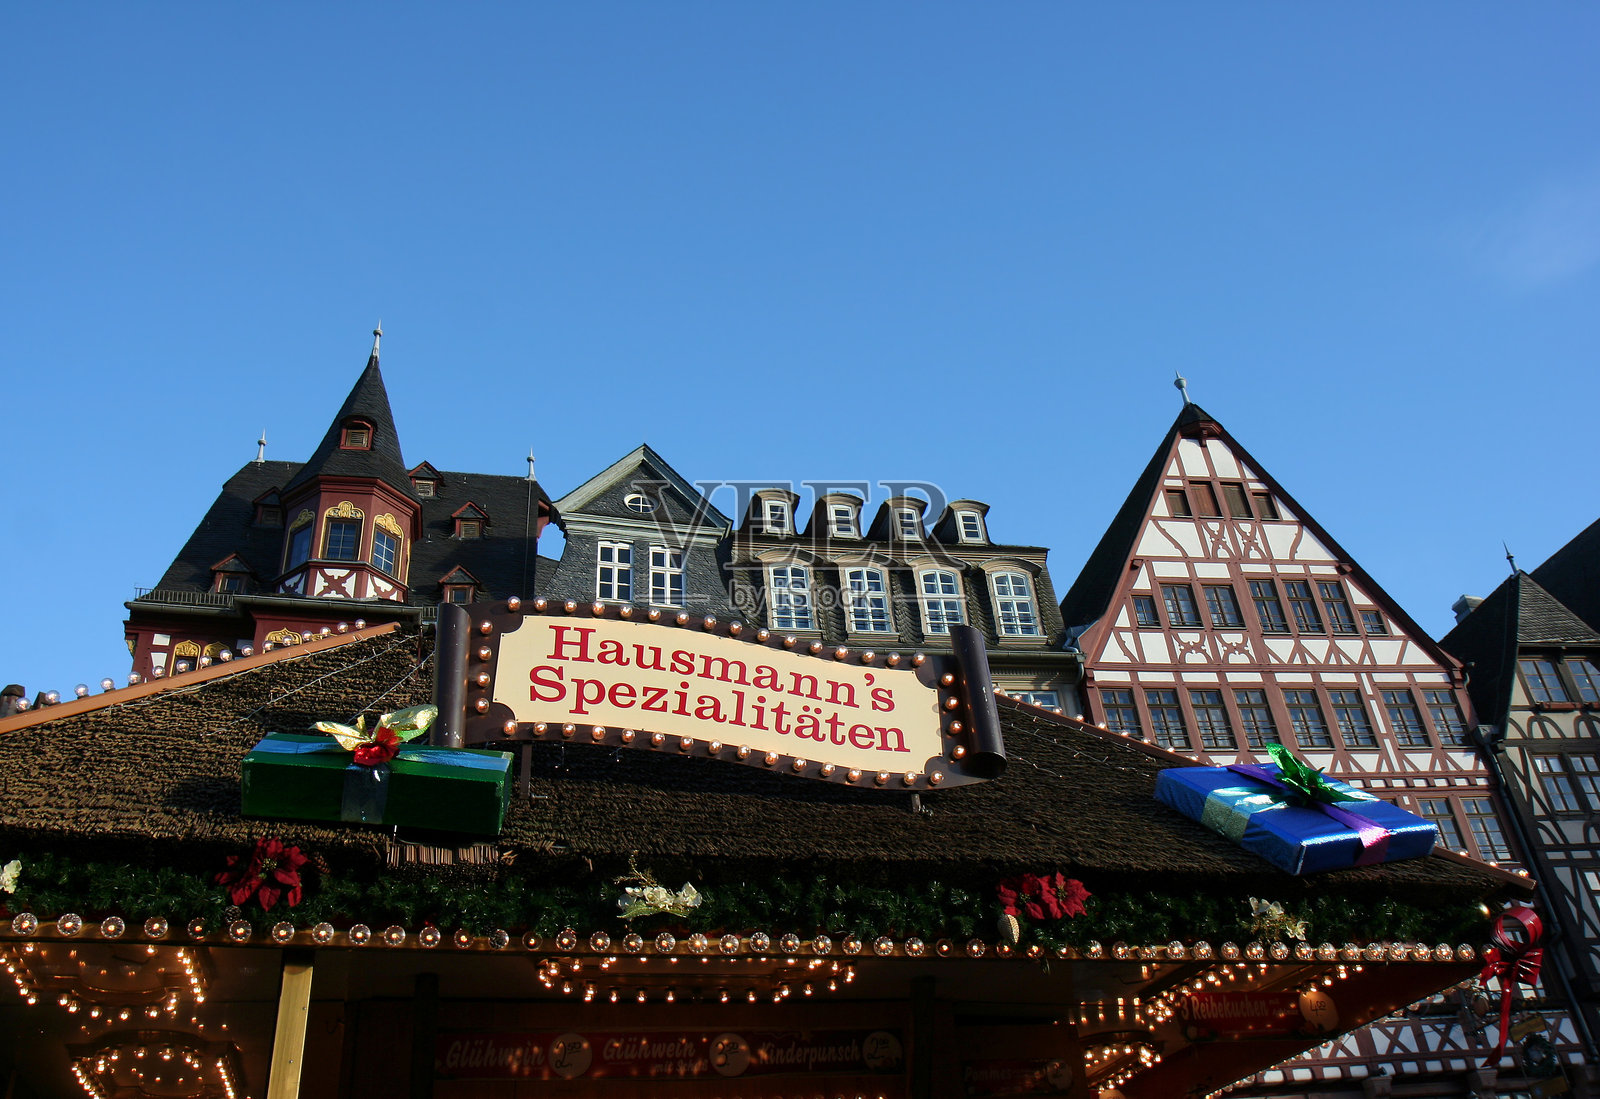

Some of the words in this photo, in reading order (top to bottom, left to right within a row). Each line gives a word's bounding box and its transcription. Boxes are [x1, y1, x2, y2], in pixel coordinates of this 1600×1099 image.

[547, 624, 895, 712] Hausmann's
[529, 665, 910, 753] Spezialitäten
[1191, 994, 1270, 1020] Reibekuchen
[446, 1040, 545, 1068] Glühwein
[602, 1037, 696, 1060] Glühwein
[758, 1038, 862, 1070] Kinderpunsch
